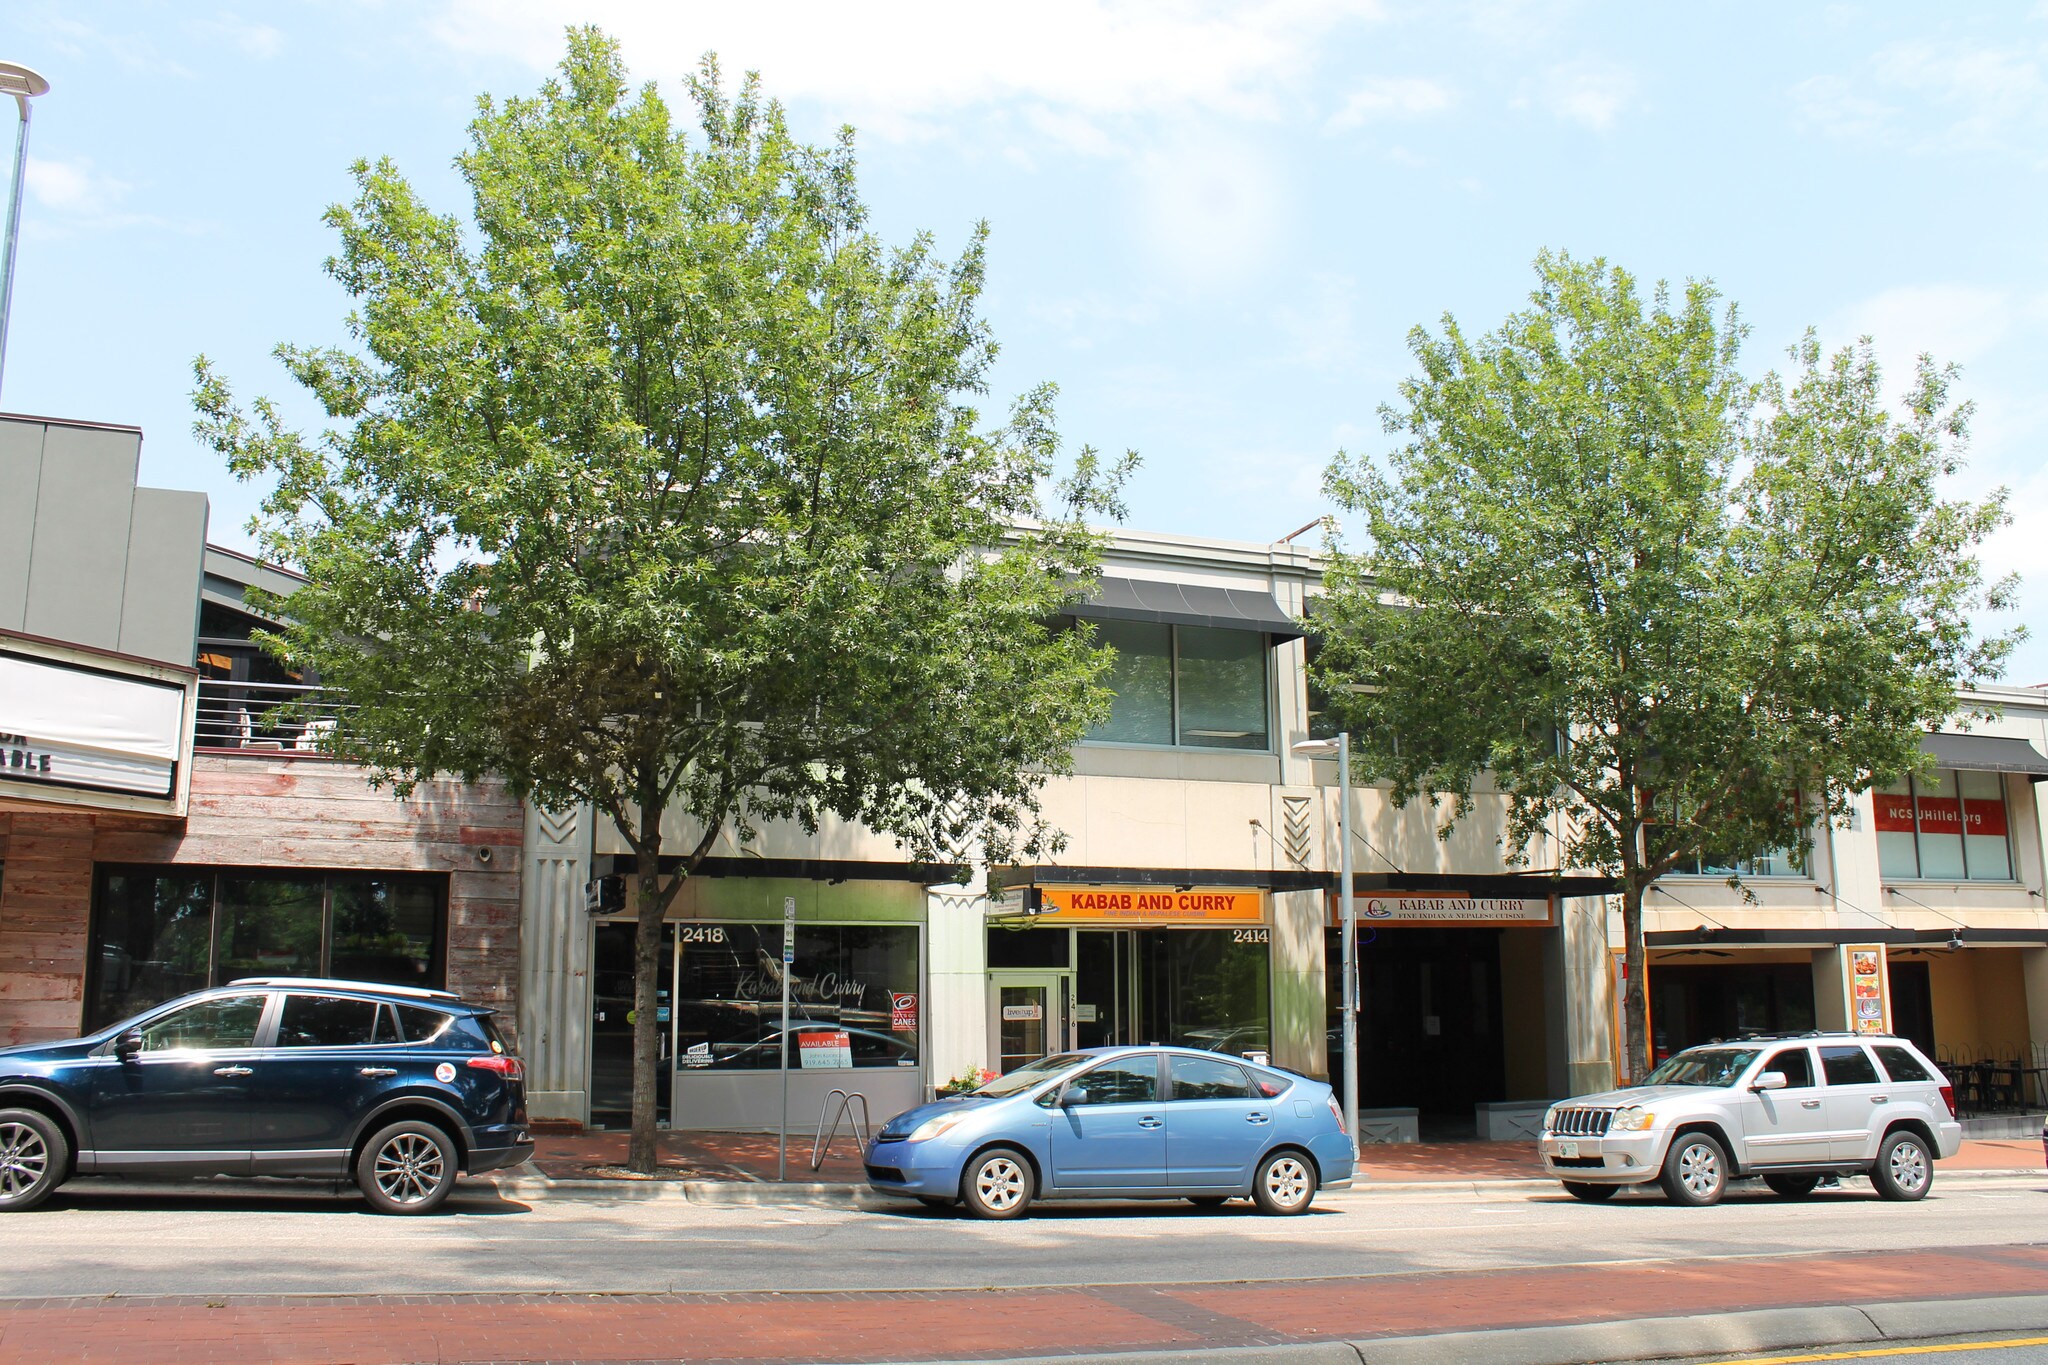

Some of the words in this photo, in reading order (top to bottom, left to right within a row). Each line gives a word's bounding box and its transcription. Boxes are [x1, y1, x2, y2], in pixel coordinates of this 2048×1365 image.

[1071, 894, 1132, 909] KABAB
[1137, 894, 1172, 910] AND
[1179, 895, 1236, 910] CURRY
[1399, 900, 1444, 911] KABAB
[1448, 900, 1476, 911] AND
[1480, 900, 1525, 911] CURRY
[682, 927, 724, 943] 2418
[1233, 929, 1269, 943] 2414
[820, 972, 866, 1006] Curry
[893, 1018, 916, 1026] CANES
[800, 1040, 840, 1048] AVAILABLE
